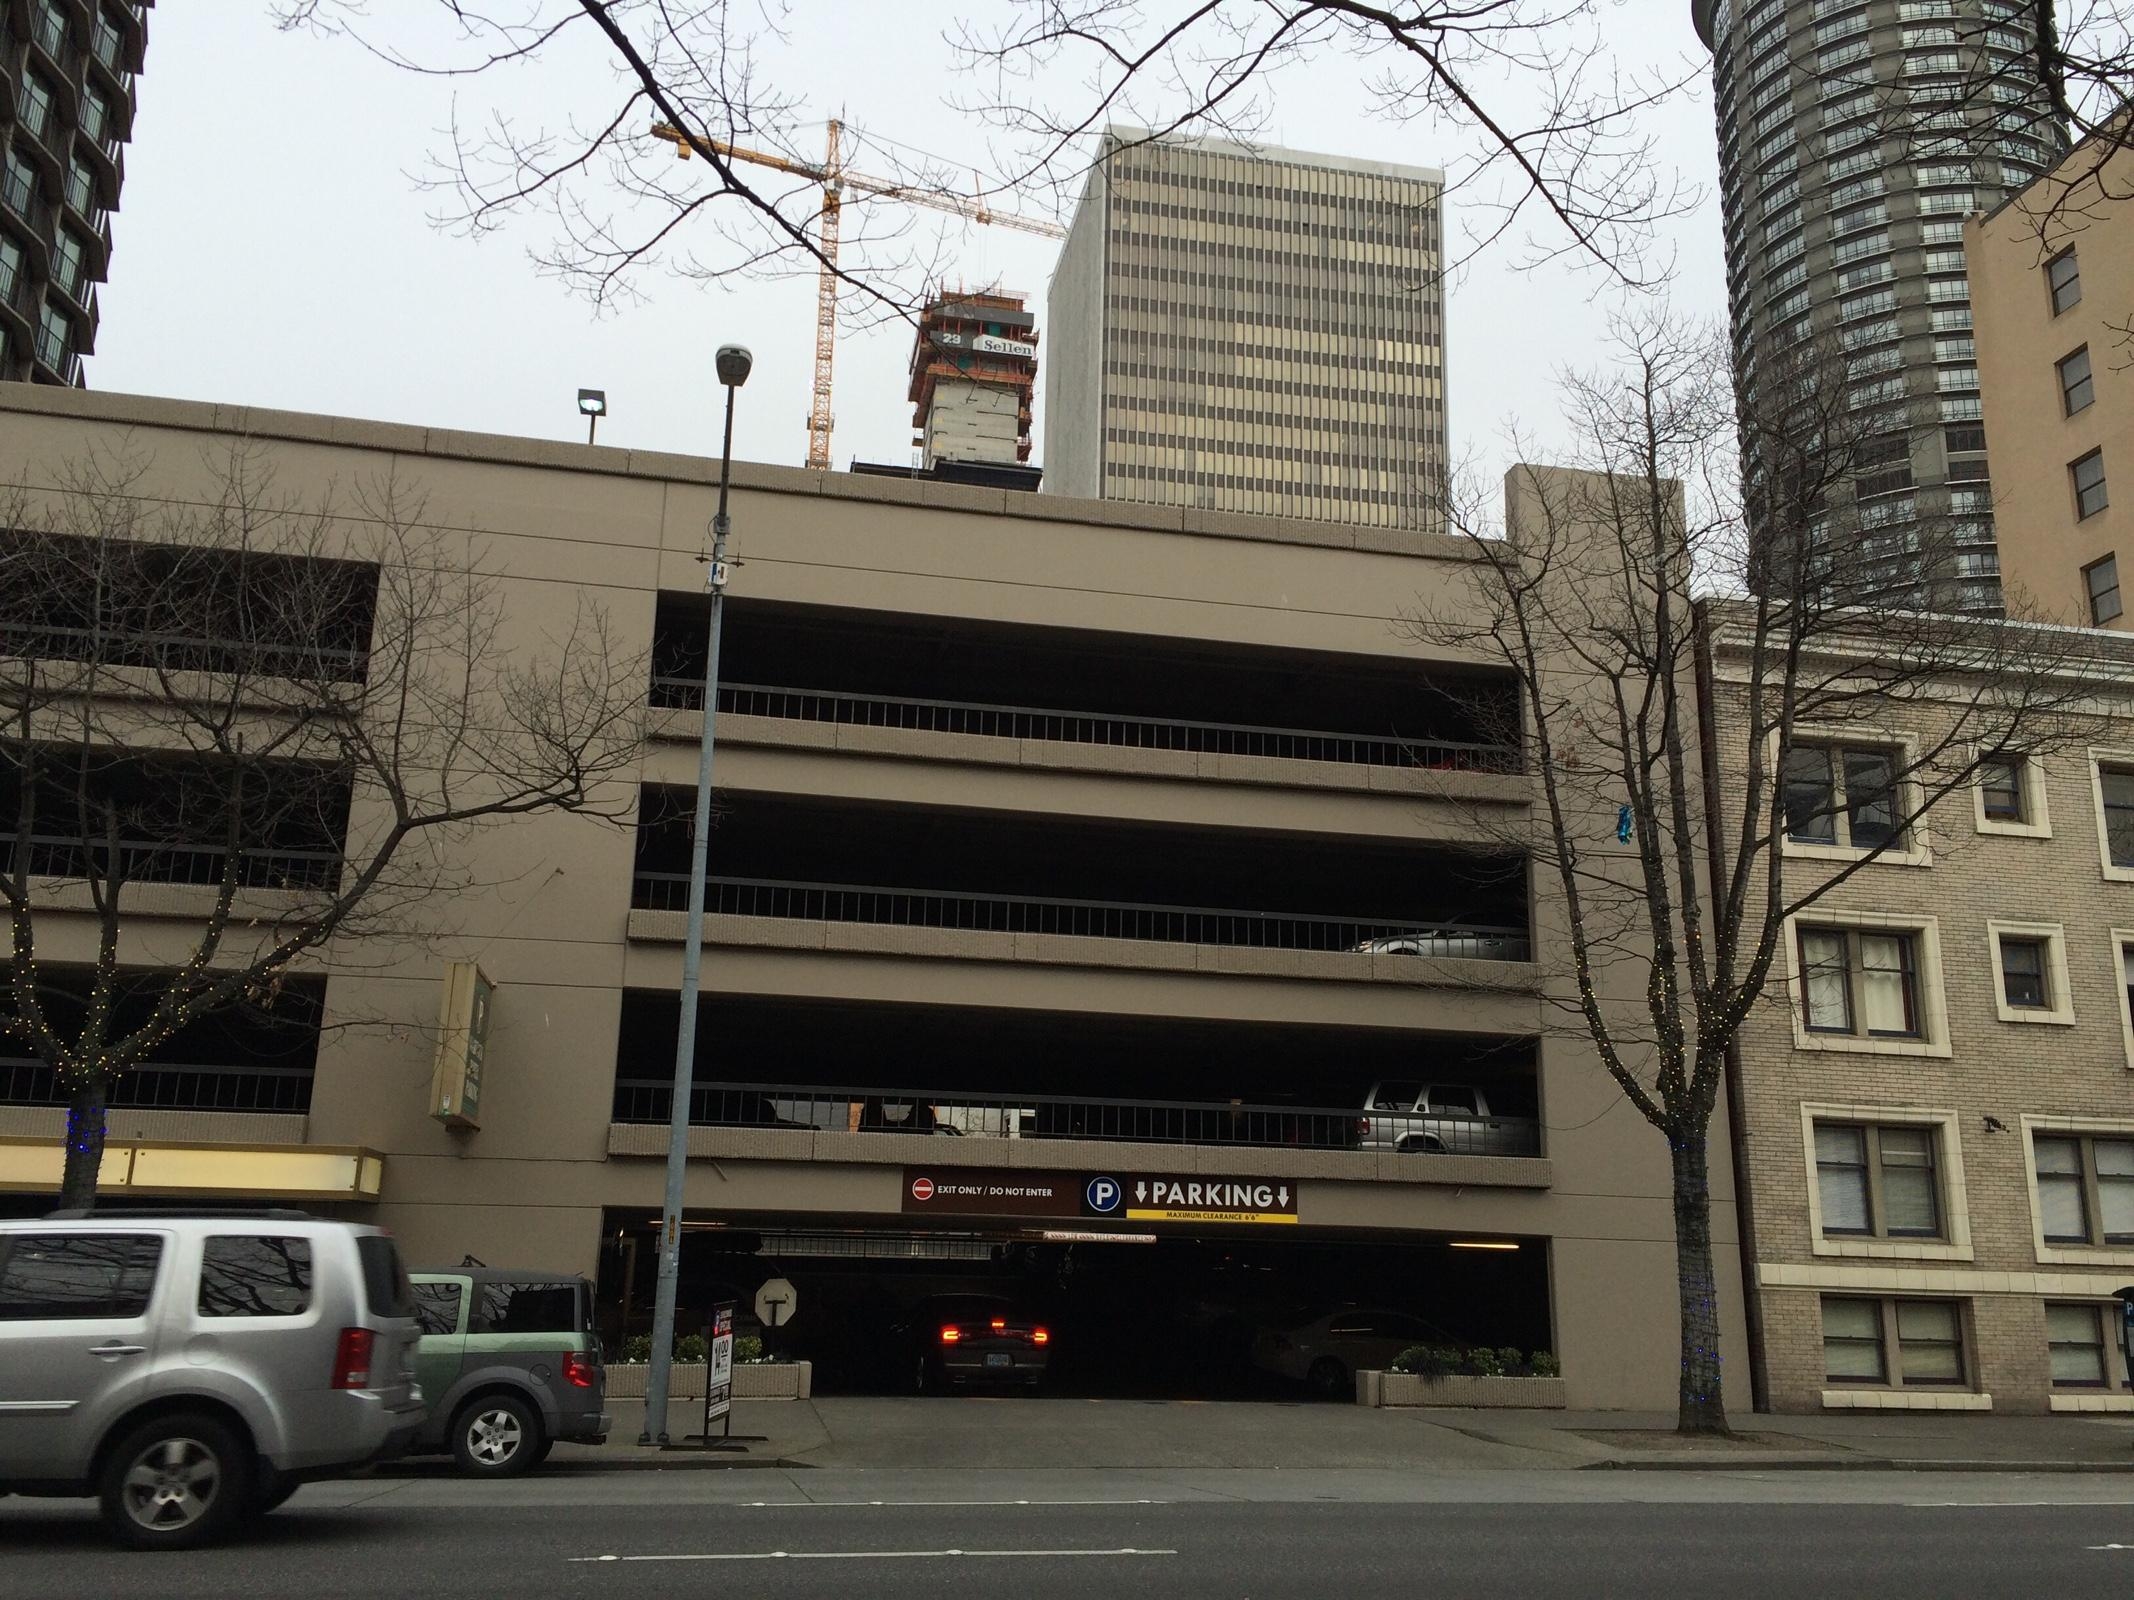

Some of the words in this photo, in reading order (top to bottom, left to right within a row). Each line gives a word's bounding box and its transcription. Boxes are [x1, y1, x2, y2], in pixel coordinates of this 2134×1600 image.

[984, 339, 1032, 355] Sellen
[937, 1185, 957, 1194] EXIT
[958, 1185, 982, 1195] ONLY
[989, 1186, 1004, 1195] DO
[1005, 1187, 1024, 1196] NOT
[1025, 1188, 1053, 1197] ENTER
[1096, 1182, 1114, 1206] P
[1152, 1181, 1274, 1208] PARKING
[1166, 1211, 1202, 1219] MAXIMUM
[1202, 1212, 1242, 1221] CLEARANCE
